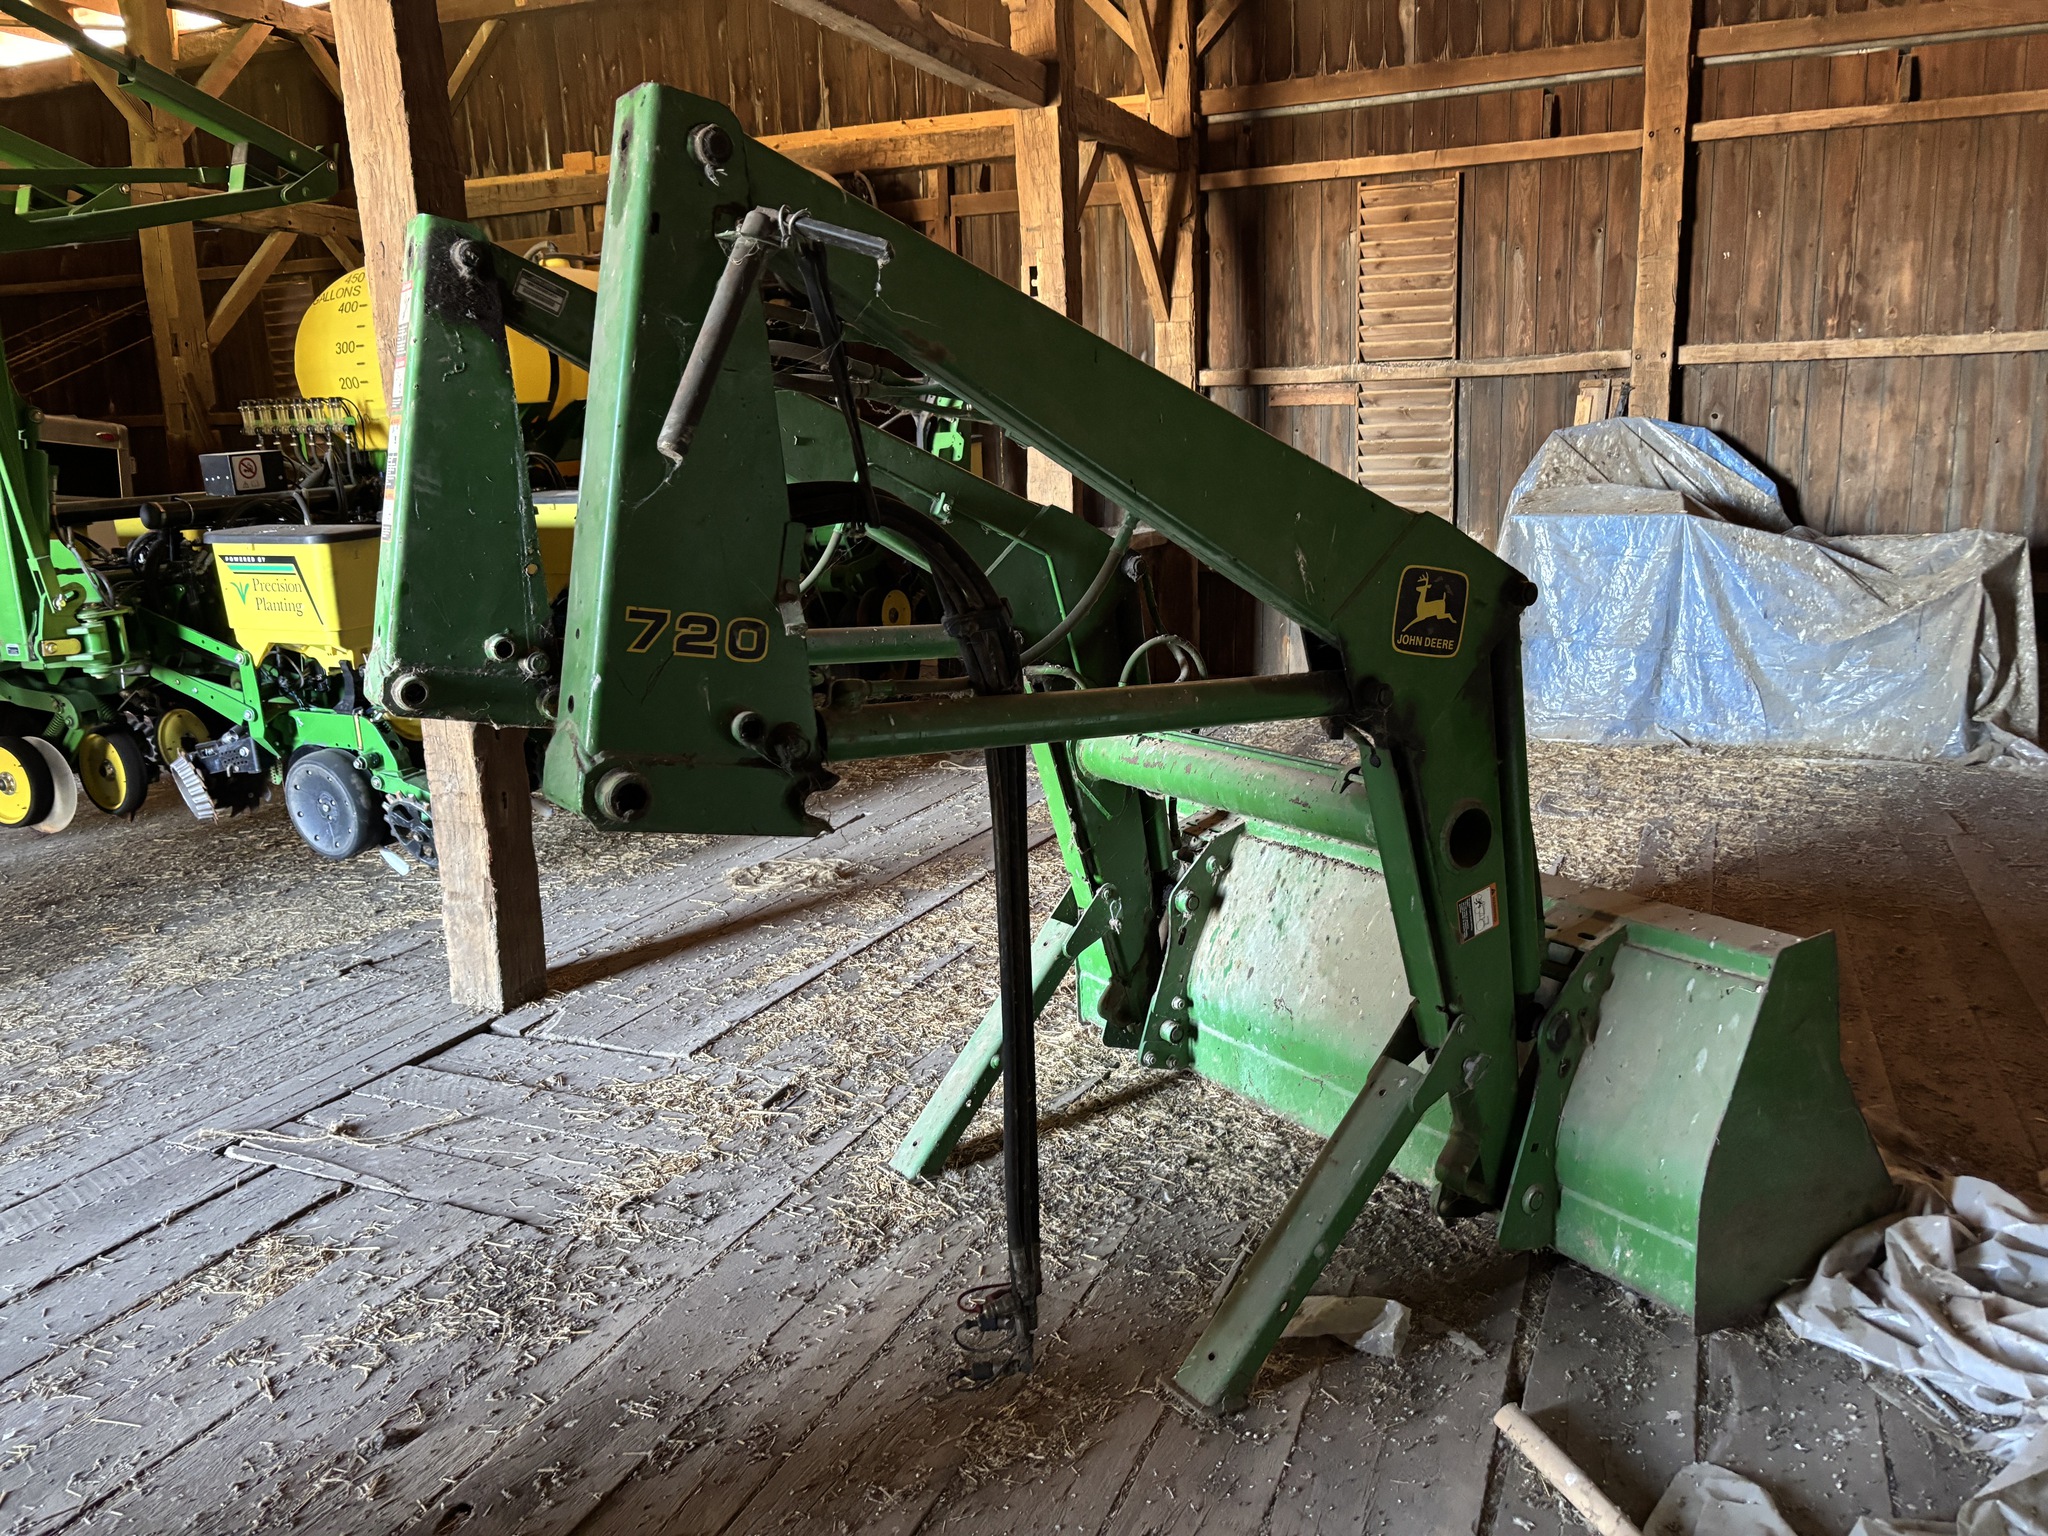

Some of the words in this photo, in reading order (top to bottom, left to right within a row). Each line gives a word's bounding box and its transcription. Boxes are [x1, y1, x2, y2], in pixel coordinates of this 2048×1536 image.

[344, 272, 366, 284] 450
[313, 285, 362, 305] GALLONS
[338, 301, 359, 313] 400
[335, 341, 356, 355] 300
[339, 376, 360, 390] 200
[252, 578, 303, 592] Precision
[255, 597, 304, 617] Planting
[625, 606, 769, 663] 720
[1397, 634, 1423, 647] JOHN
[1424, 637, 1455, 650] DEERE
